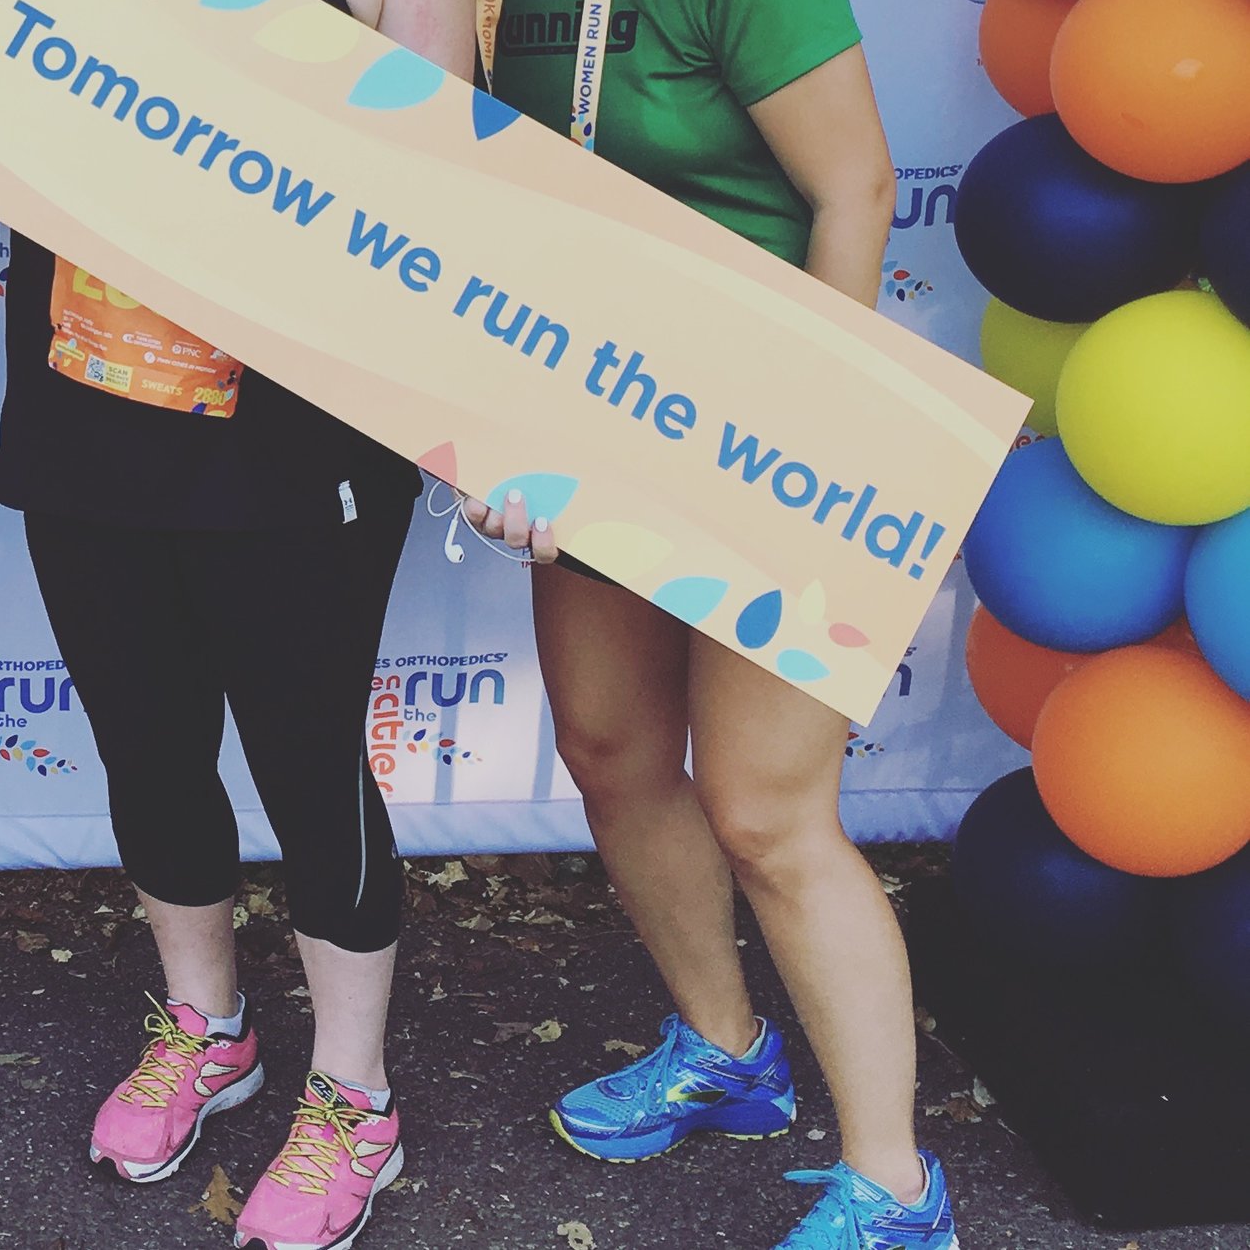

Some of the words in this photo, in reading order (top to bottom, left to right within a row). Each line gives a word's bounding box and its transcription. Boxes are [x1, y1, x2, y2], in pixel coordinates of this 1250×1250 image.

[577, 47, 597, 115] WOMEN
[587, 3, 603, 40] RUN
[5, 0, 334, 227] Tomorrow
[347, 210, 442, 293] we
[453, 276, 570, 370] run
[585, 341, 697, 440] the
[718, 422, 945, 579] world!
[182, 347, 202, 358] PNC
[141, 379, 183, 396] SWEATS
